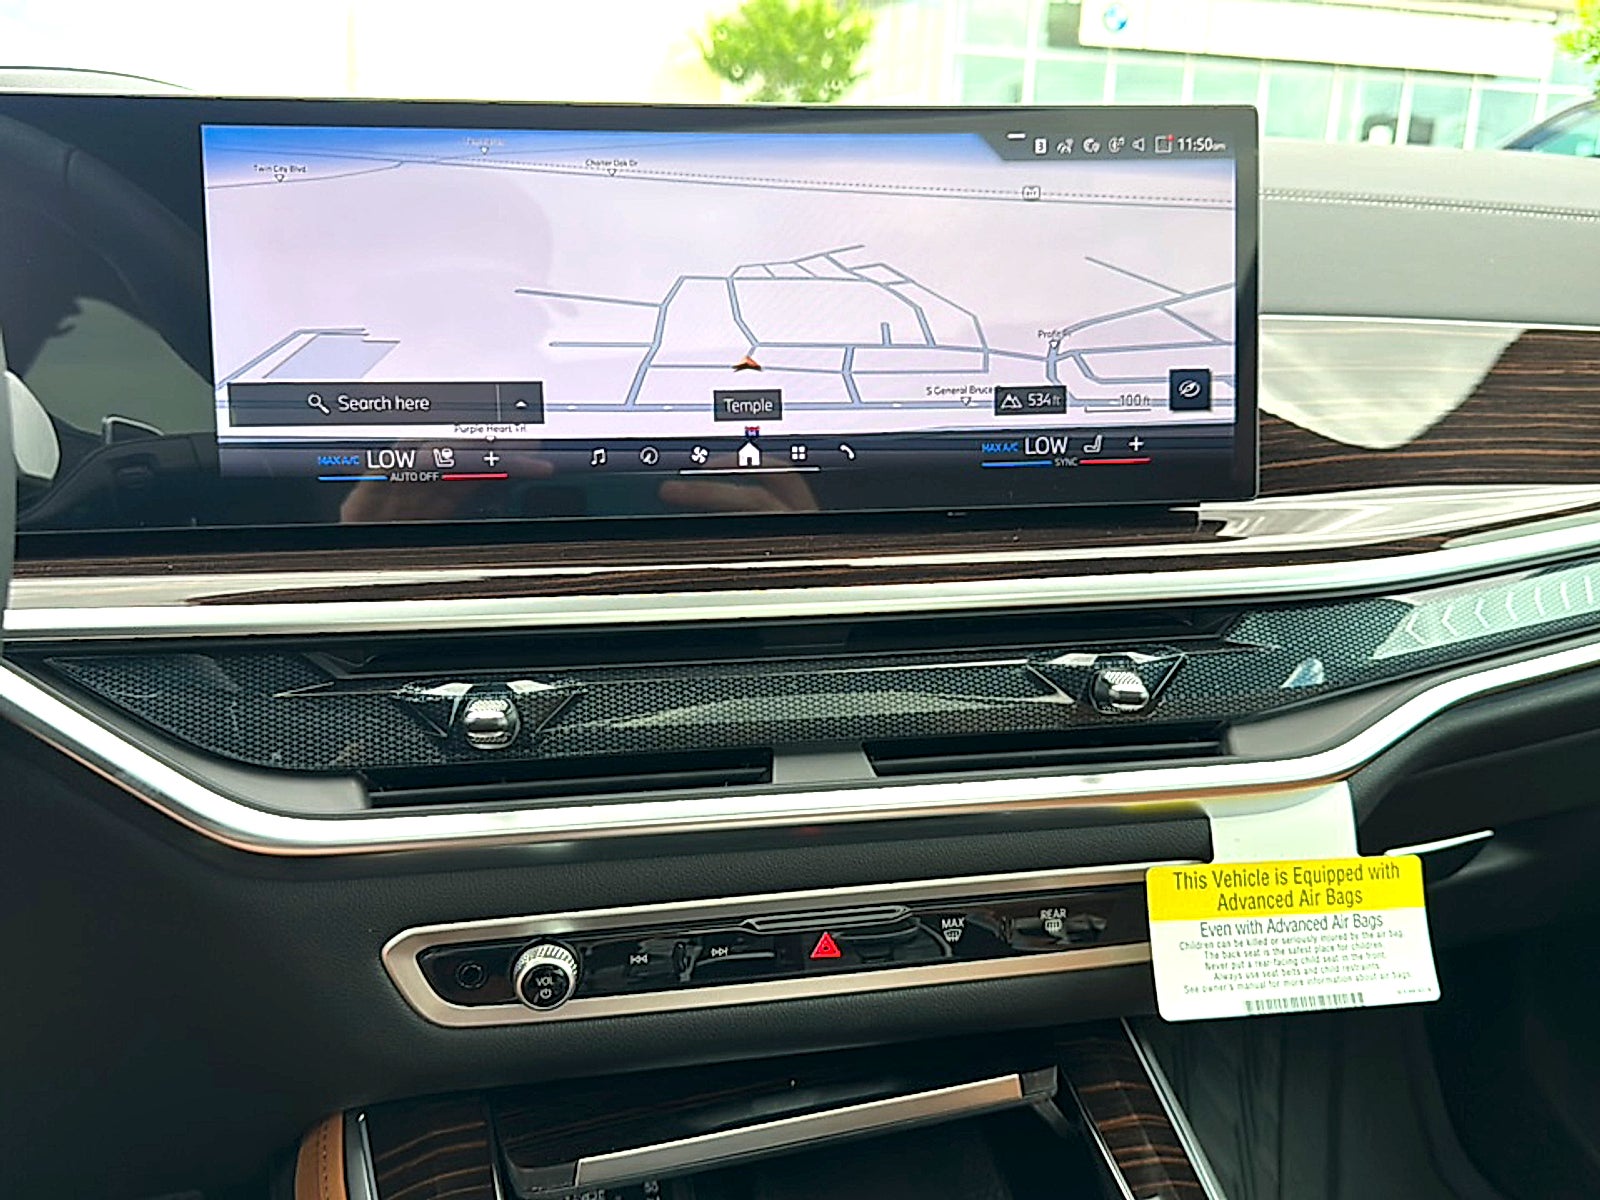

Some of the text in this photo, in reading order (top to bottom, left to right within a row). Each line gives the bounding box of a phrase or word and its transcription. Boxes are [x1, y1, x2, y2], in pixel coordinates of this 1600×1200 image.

[926, 384, 993, 396] S General Bruce
[338, 394, 430, 411] Search here
[724, 398, 773, 416] Temple
[454, 423, 484, 434] Purple
[486, 424, 513, 433] Heart
[1024, 436, 1069, 455] LOW
[318, 455, 340, 465] MAX
[366, 449, 415, 469] LOW
[1054, 456, 1079, 467] SYNC
[390, 471, 439, 481] AUTO OFF
[1173, 862, 1400, 891] This Vehicle is Equipped with
[1217, 888, 1363, 912] Advanced Air Bags
[1040, 908, 1067, 920] REAR
[941, 917, 965, 929] MAX
[1200, 912, 1384, 938] Even with Advanced Air Bags
[1179, 939, 1214, 951] Children
[1217, 940, 1232, 949] can
[1233, 938, 1244, 948] be
[1246, 937, 1268, 947] killed
[1282, 934, 1318, 946] seriously
[1204, 950, 1219, 960] The
[1221, 949, 1241, 959] back
[1243, 948, 1261, 958] seat
[1272, 947, 1285, 957] the
[1314, 943, 1335, 955] place
[1204, 961, 1229, 971] Never
[1231, 961, 1245, 972] put
[535, 976, 554, 987] VOL
[1213, 970, 1242, 982] Always
[1184, 984, 1199, 995] See
